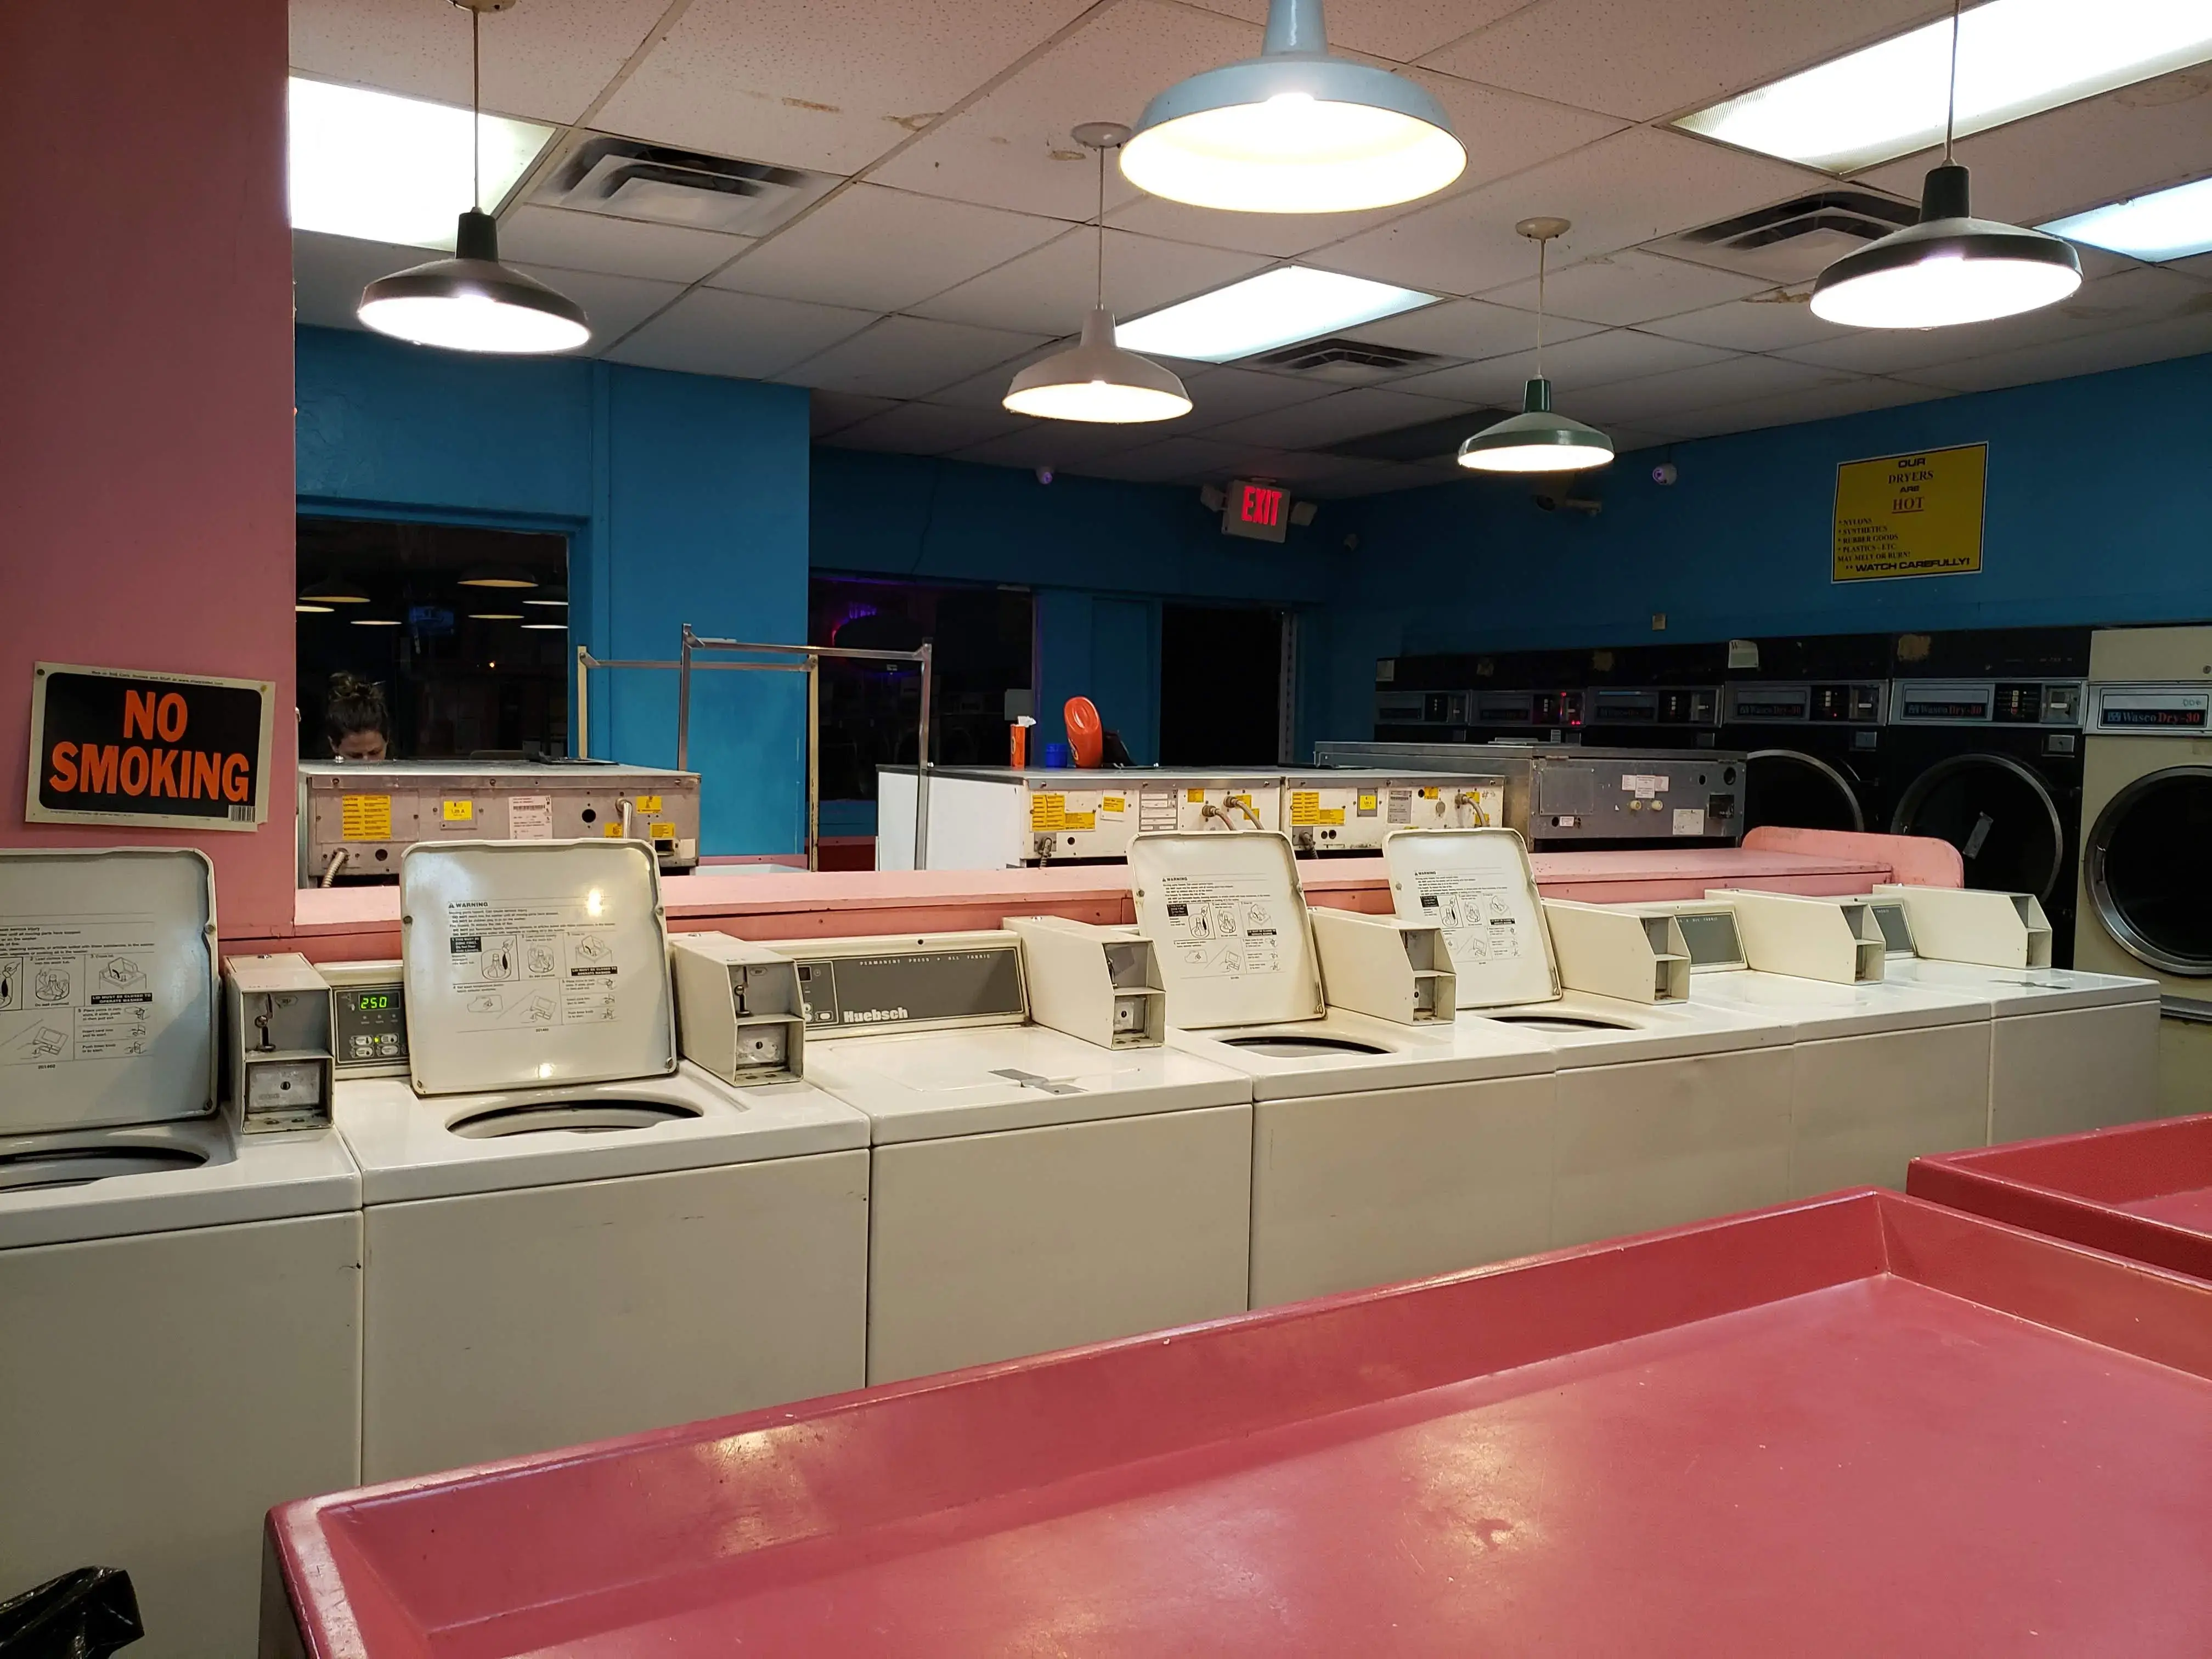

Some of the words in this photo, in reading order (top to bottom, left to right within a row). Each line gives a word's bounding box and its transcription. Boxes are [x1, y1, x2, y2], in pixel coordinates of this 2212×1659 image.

[1898, 458, 1926, 468] OUR
[1888, 470, 1934, 483] DRYERS
[1241, 485, 1282, 526] EXIT
[1892, 496, 1924, 511] HOT
[1843, 526, 1887, 534] SYNTHETICS
[1843, 536, 1871, 544] RUBBER
[1843, 545, 1875, 553] PLASTICS
[1855, 562, 1897, 572] WATCH
[1899, 557, 1971, 569] CAREFULLY!
[123, 690, 188, 742] NO
[2122, 711, 2157, 723] Wasco
[49, 741, 250, 802] SMOKING
[360, 996, 387, 1009] 250
[843, 1007, 909, 1023] Huebsch
